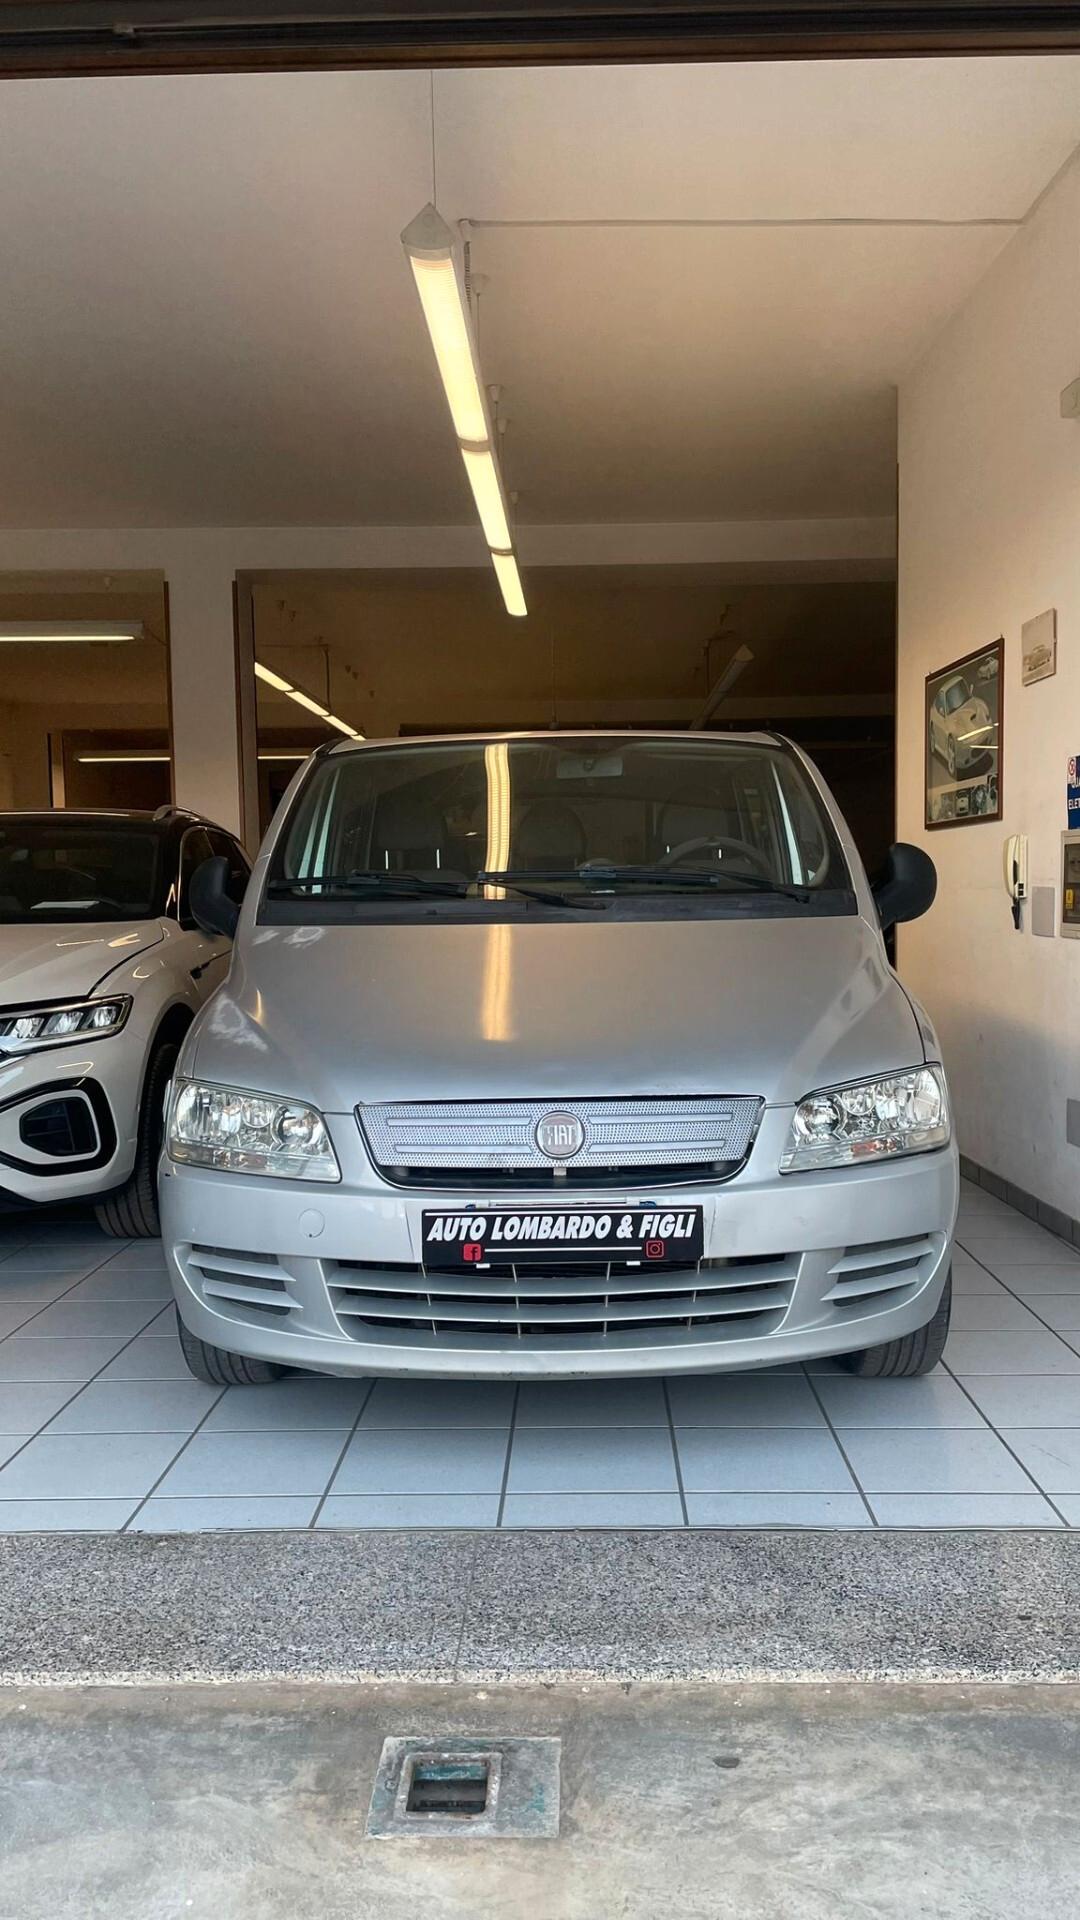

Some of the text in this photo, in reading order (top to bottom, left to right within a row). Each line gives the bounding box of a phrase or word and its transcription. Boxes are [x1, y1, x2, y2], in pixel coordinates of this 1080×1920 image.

[544, 1124, 574, 1145] FIAT
[427, 1213, 696, 1241] AUTO LOMBARDO & FIGLI
